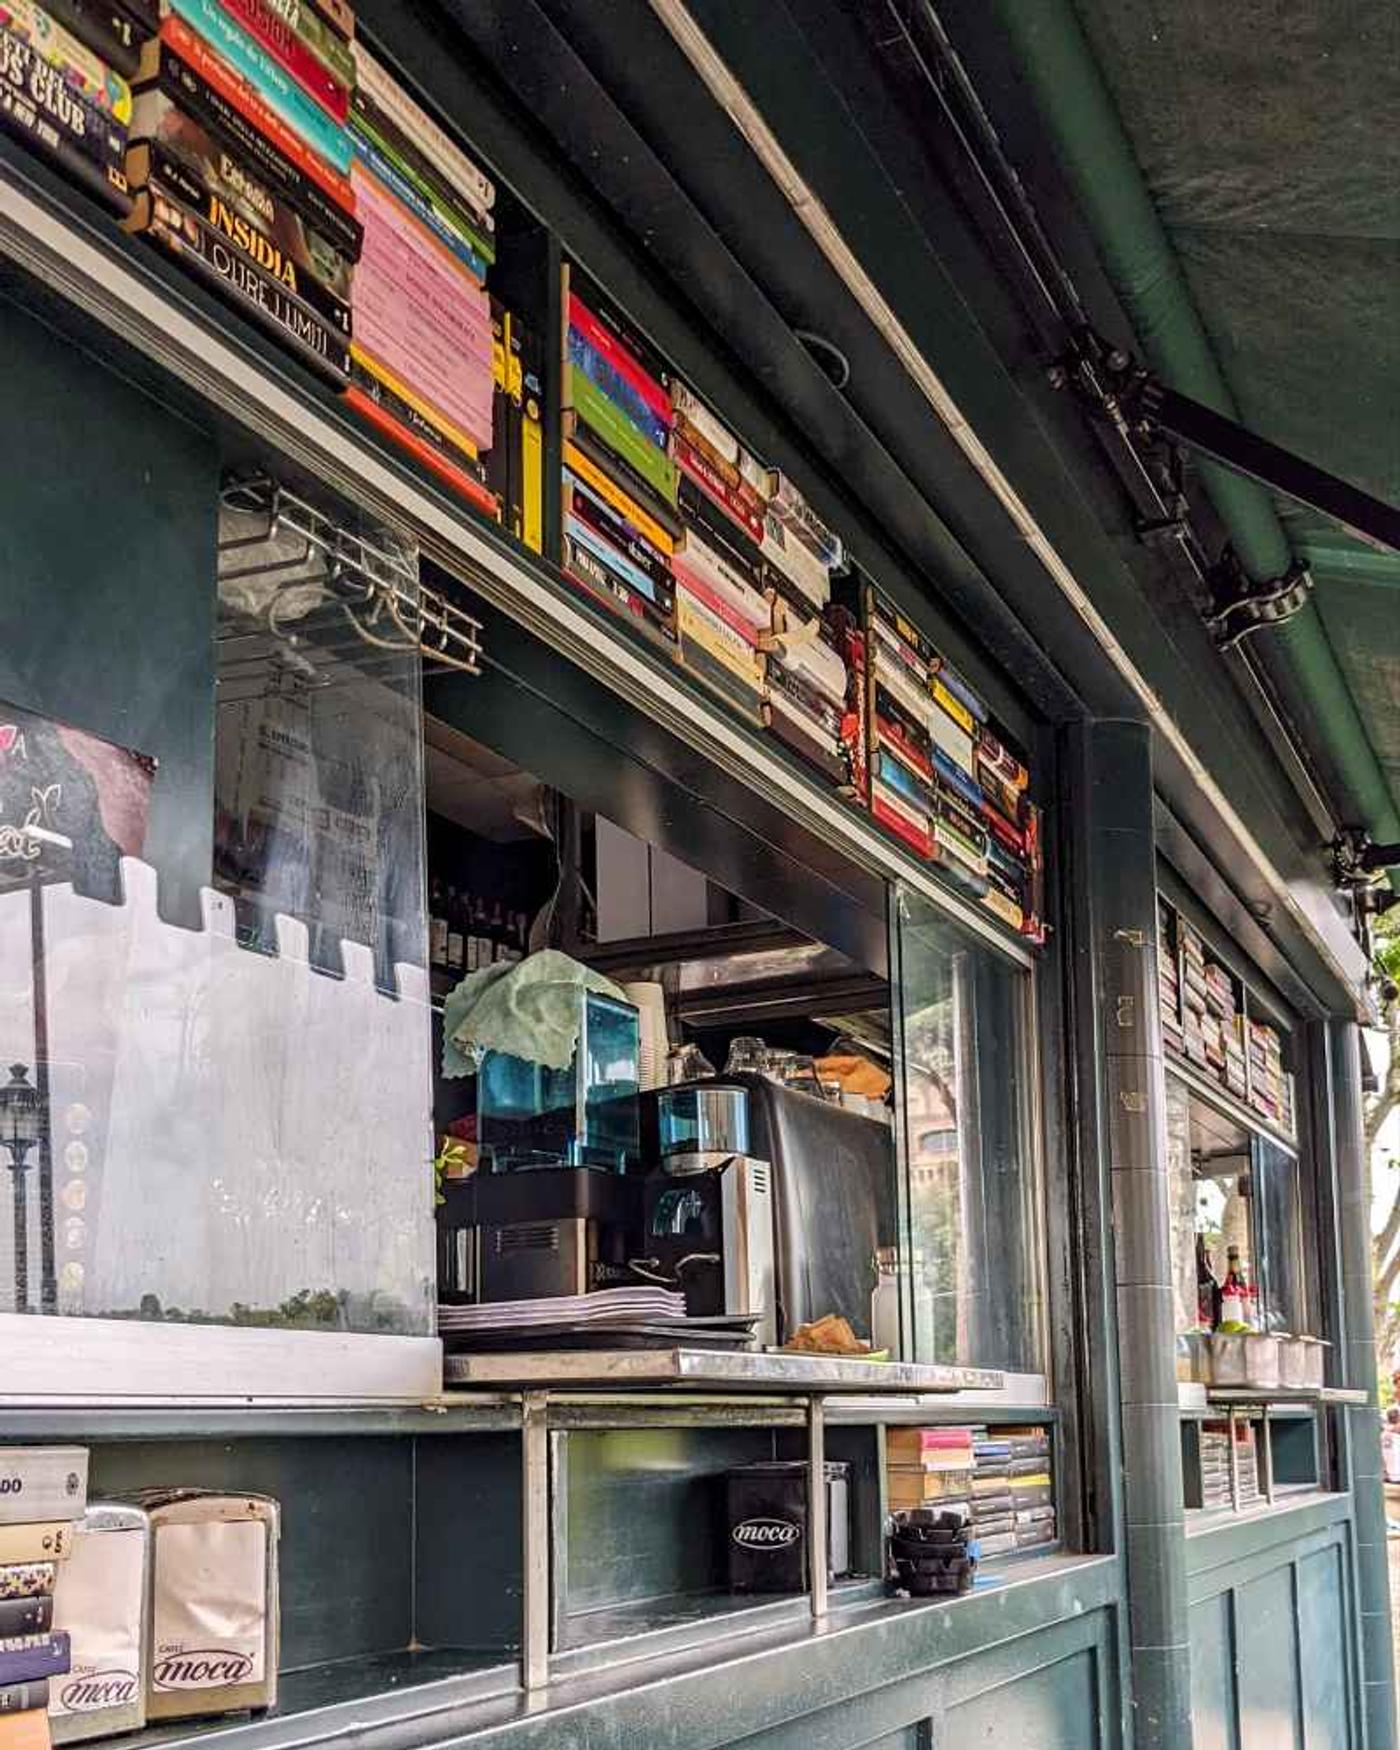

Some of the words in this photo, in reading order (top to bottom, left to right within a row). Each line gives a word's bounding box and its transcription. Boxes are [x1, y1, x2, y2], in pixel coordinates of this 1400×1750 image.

[30, 71, 86, 136] CLUB
[209, 195, 297, 294] INSIDIA
[213, 243, 269, 309] OLTRE
[736, 1524, 797, 1542] moca
[65, 1680, 137, 1705] moca
[155, 1659, 248, 1683] moca
